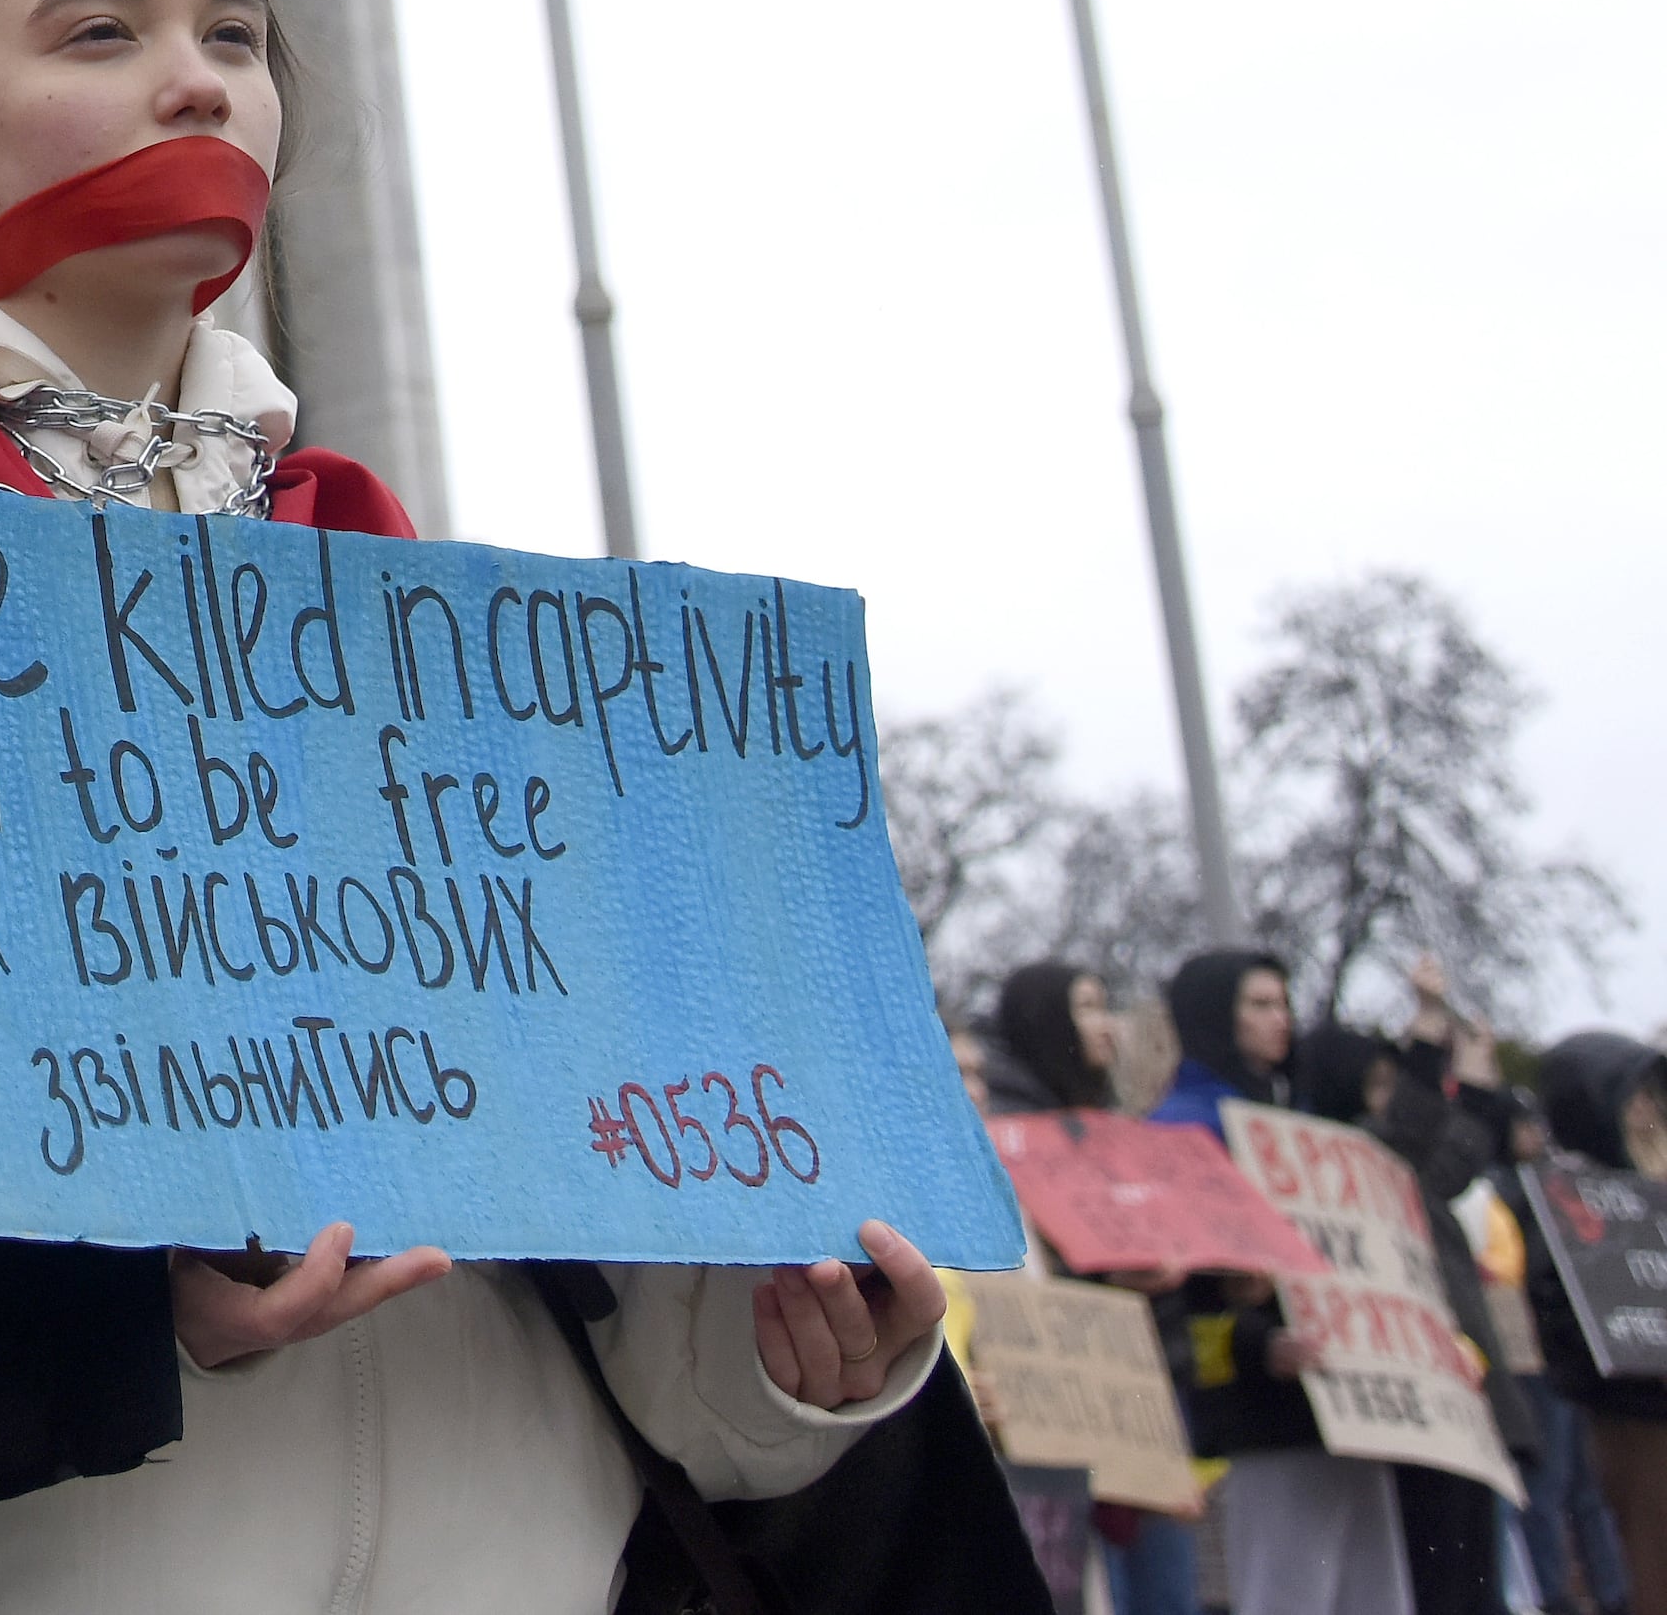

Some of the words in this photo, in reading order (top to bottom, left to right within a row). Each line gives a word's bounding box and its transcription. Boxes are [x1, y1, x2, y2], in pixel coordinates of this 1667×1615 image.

[92, 513, 356, 722] kiled
[380, 572, 473, 721] in
[488, 567, 869, 829] captivity
[60, 707, 163, 844] to
[187, 714, 299, 848] be
[378, 724, 567, 866] free
[60, 847, 569, 996] військових
[31, 1014, 478, 1177] звільнитись
[586, 1063, 821, 1189] #0536
